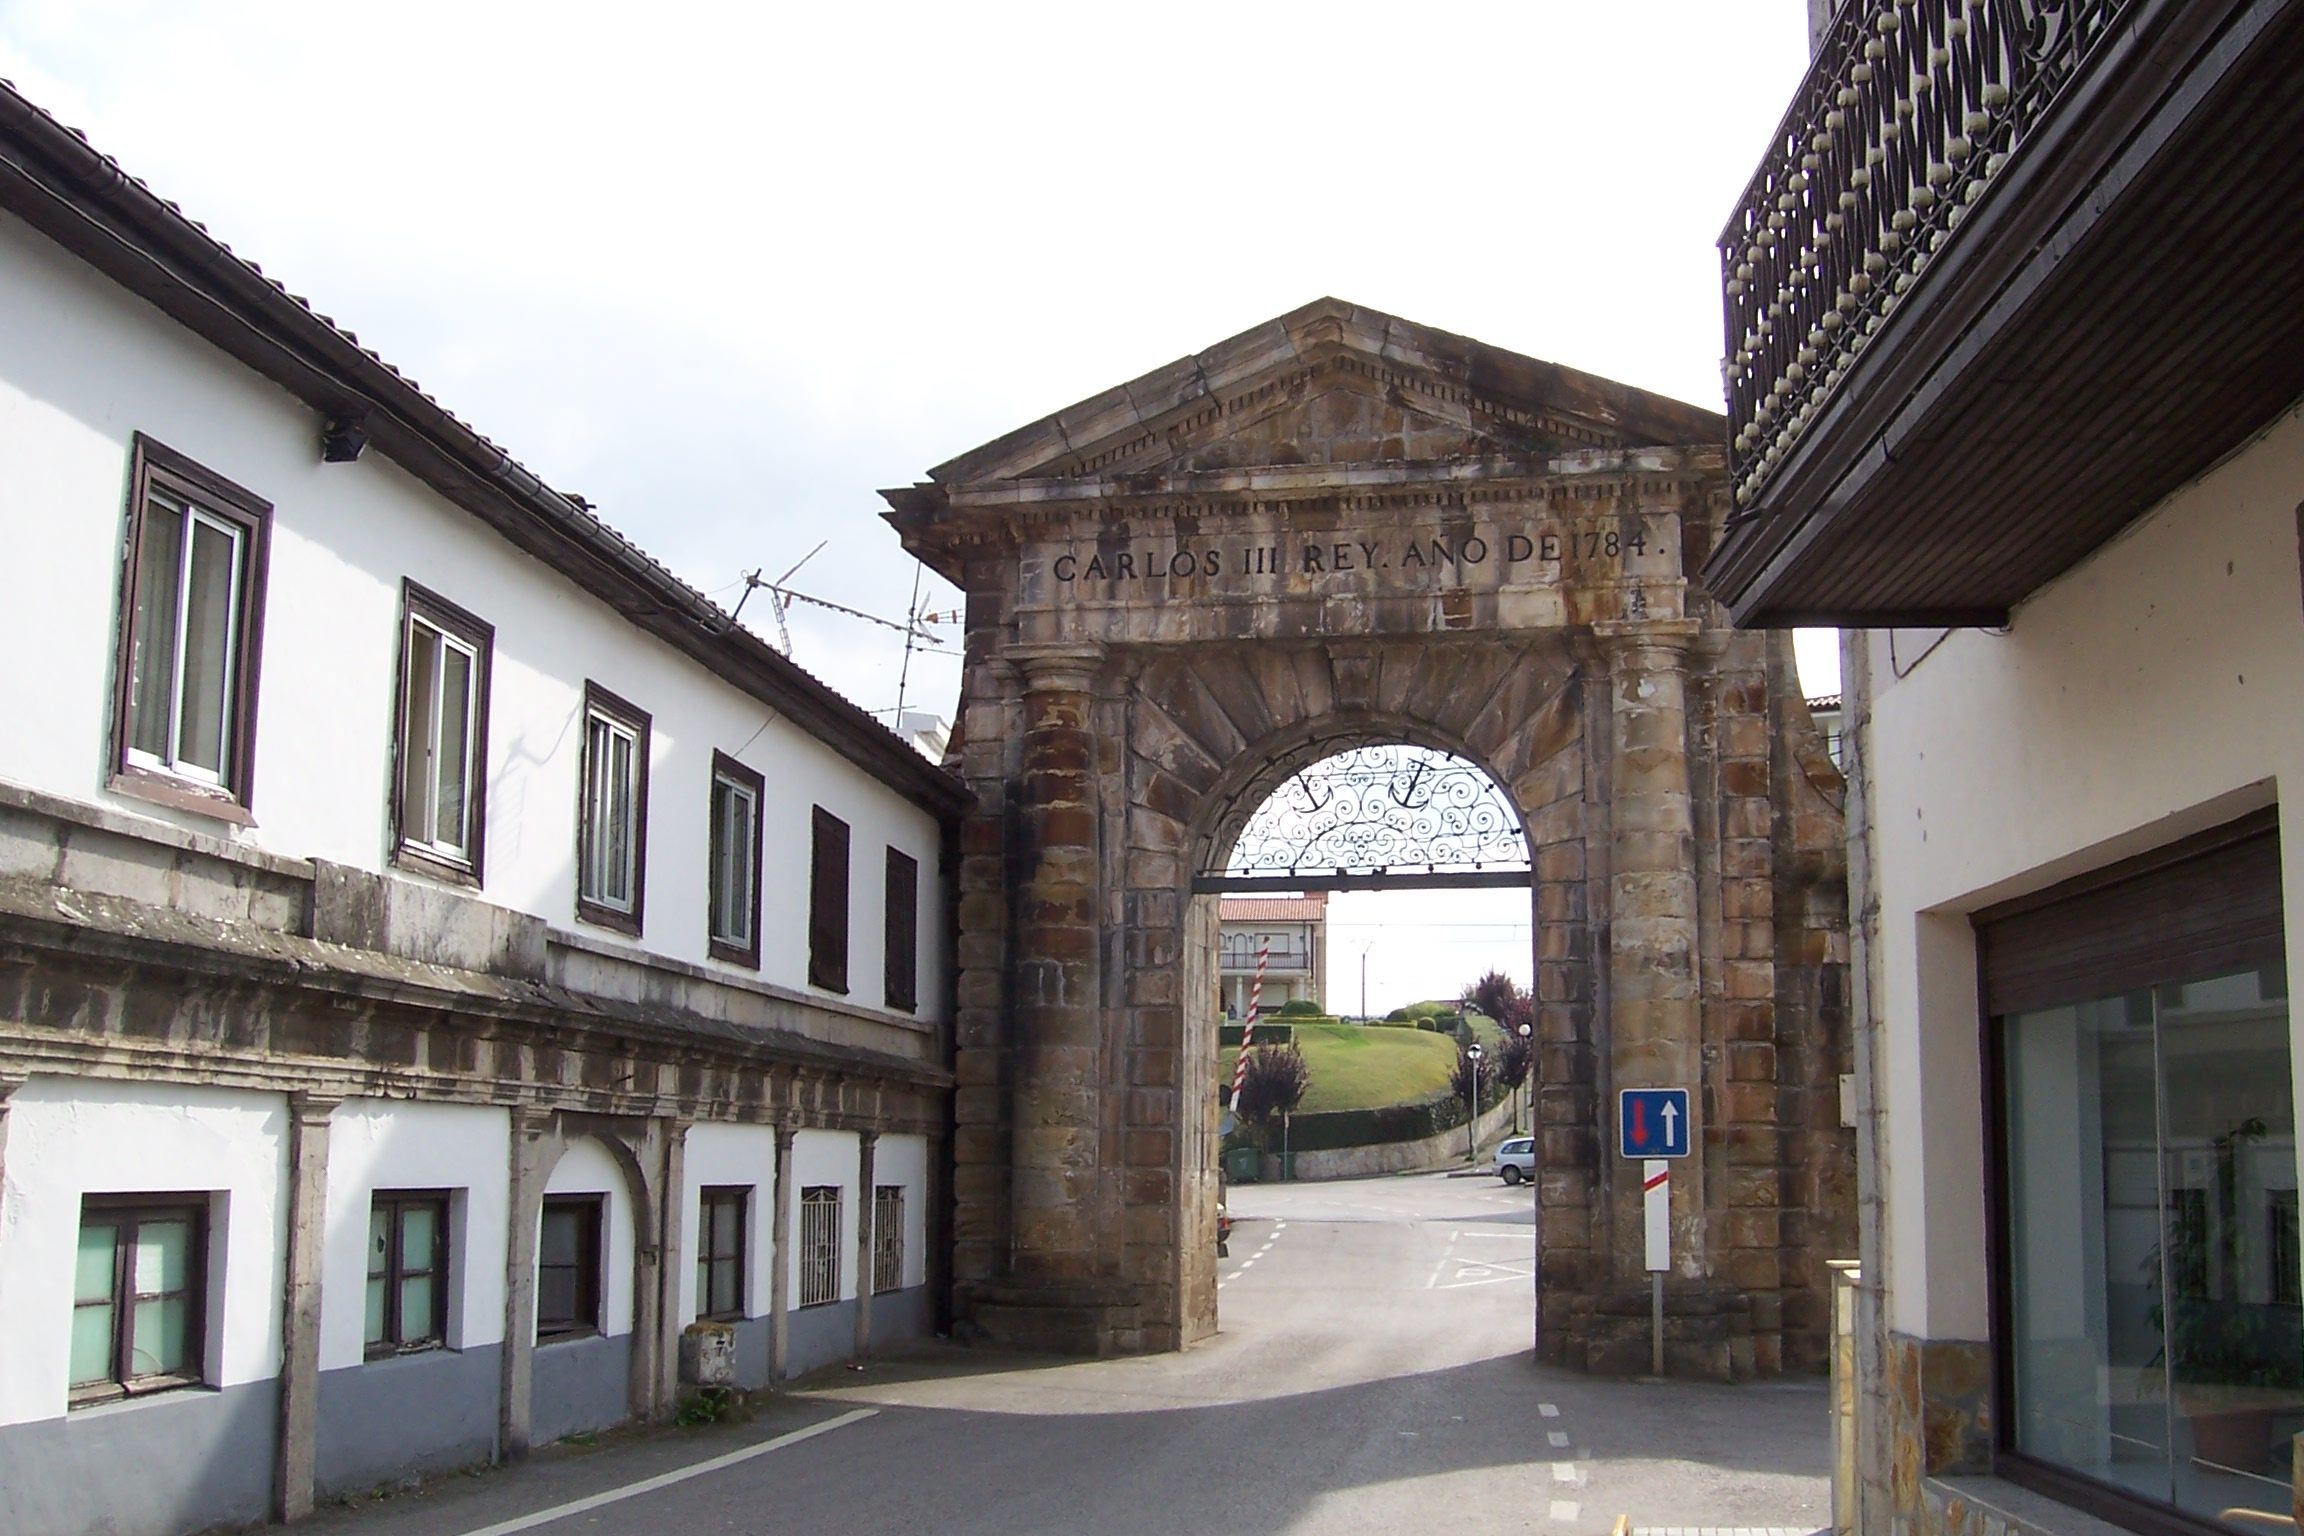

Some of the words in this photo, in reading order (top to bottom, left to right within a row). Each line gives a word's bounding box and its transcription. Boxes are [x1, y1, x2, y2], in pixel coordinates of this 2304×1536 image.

[1053, 550, 1220, 581] CARLOS
[1243, 546, 1277, 574] III
[1303, 541, 1388, 573] REY.
[1507, 534, 1561, 562] DE
